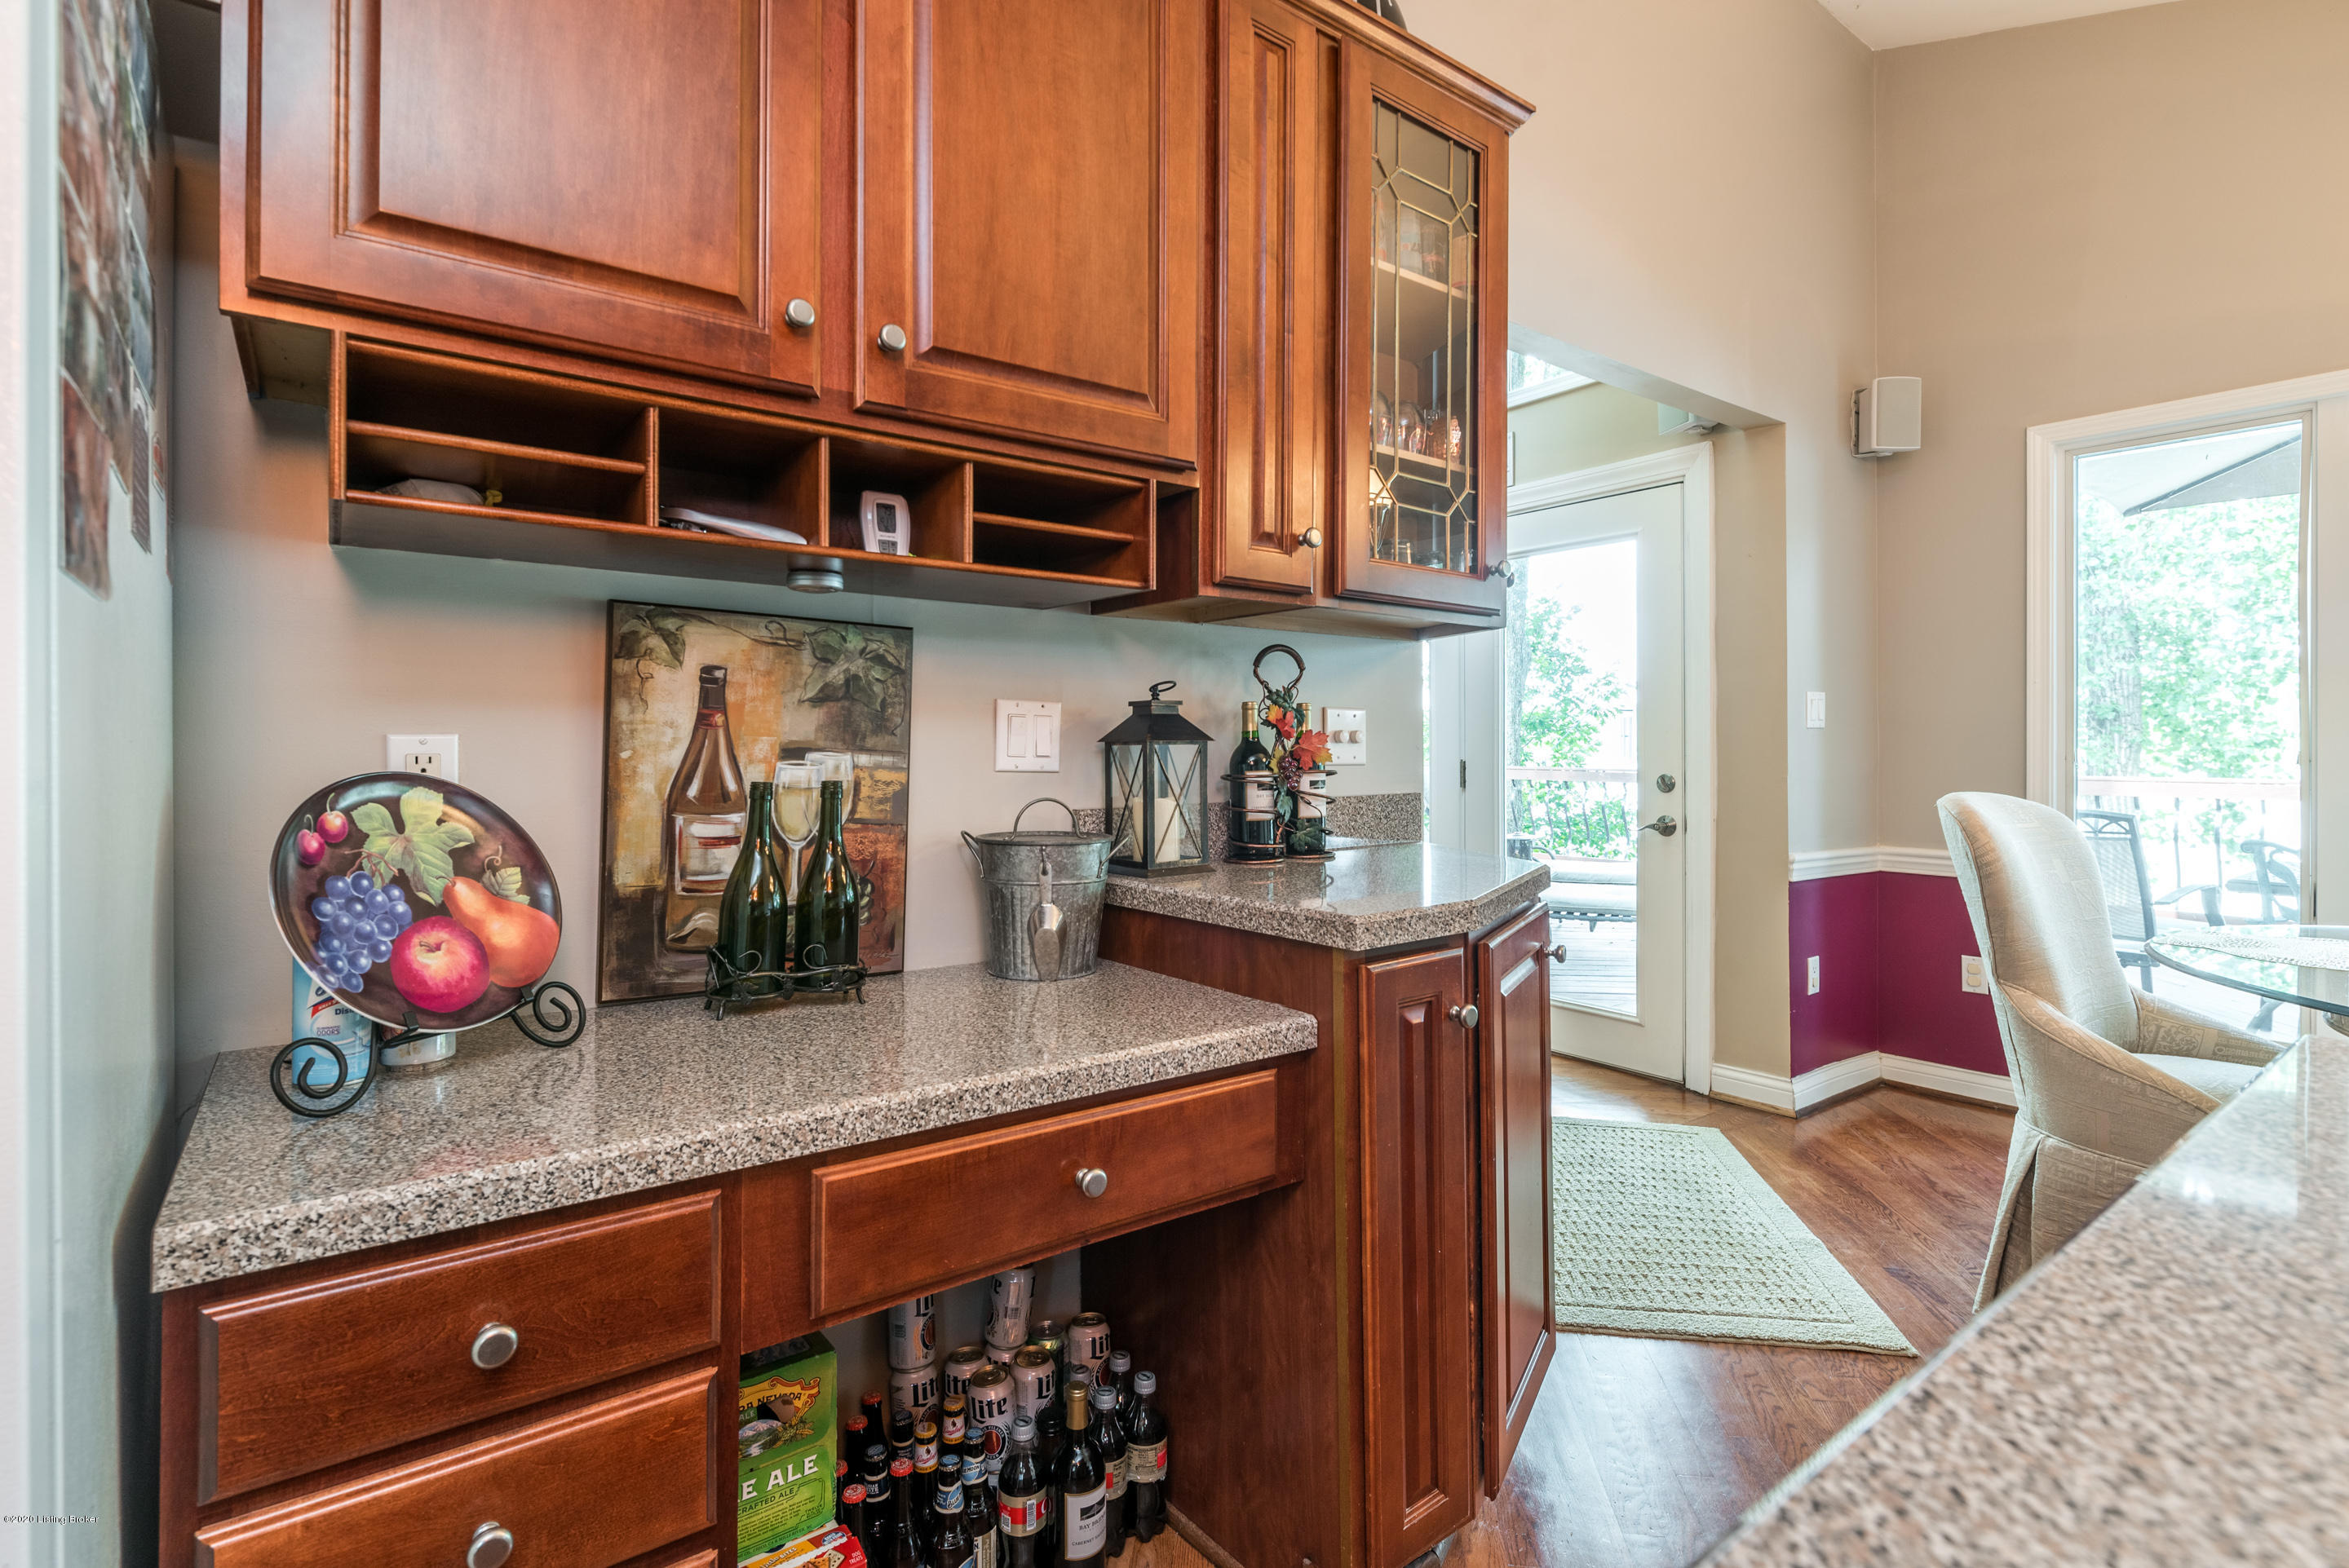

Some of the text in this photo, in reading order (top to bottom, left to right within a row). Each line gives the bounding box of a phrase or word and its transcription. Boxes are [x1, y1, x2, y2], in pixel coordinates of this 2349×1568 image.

[757, 1392, 803, 1405] NEVDA
[739, 1410, 755, 1420] ALE
[970, 1396, 1008, 1424] Lite
[767, 1454, 819, 1491] ALE
[779, 1488, 794, 1500] ALE
[849, 1555, 863, 1565] TREATS
